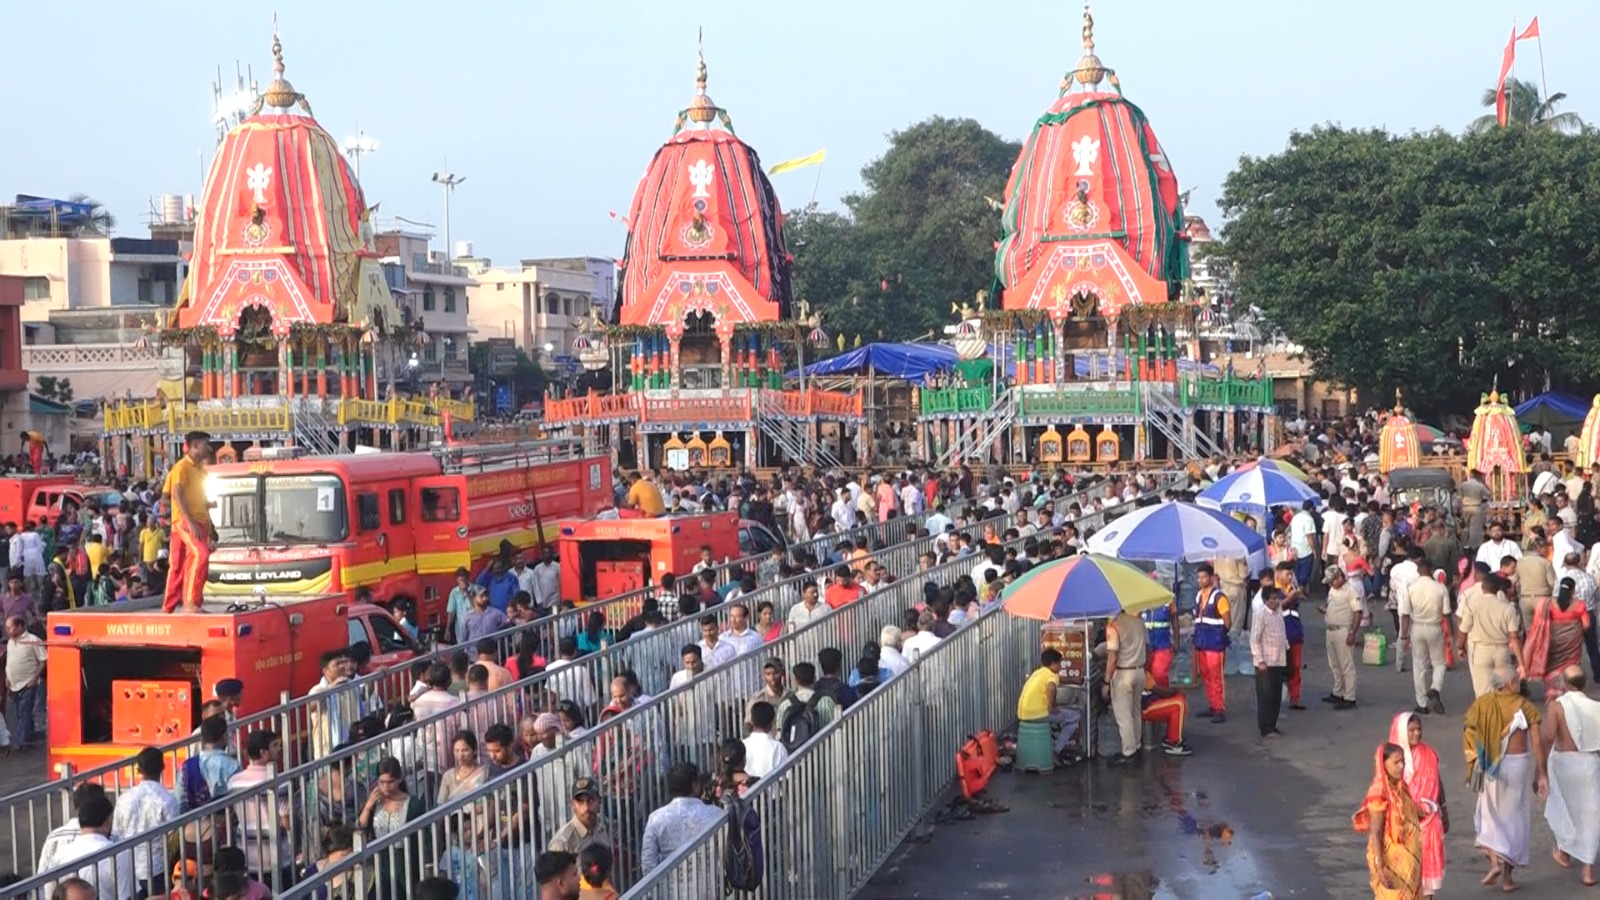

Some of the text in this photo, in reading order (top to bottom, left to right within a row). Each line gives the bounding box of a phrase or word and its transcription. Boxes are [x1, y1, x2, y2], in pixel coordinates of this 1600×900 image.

[320, 494, 330, 508] 1
[219, 571, 301, 581] ASHOK LEYLAND
[106, 624, 172, 635] WATER MIST
